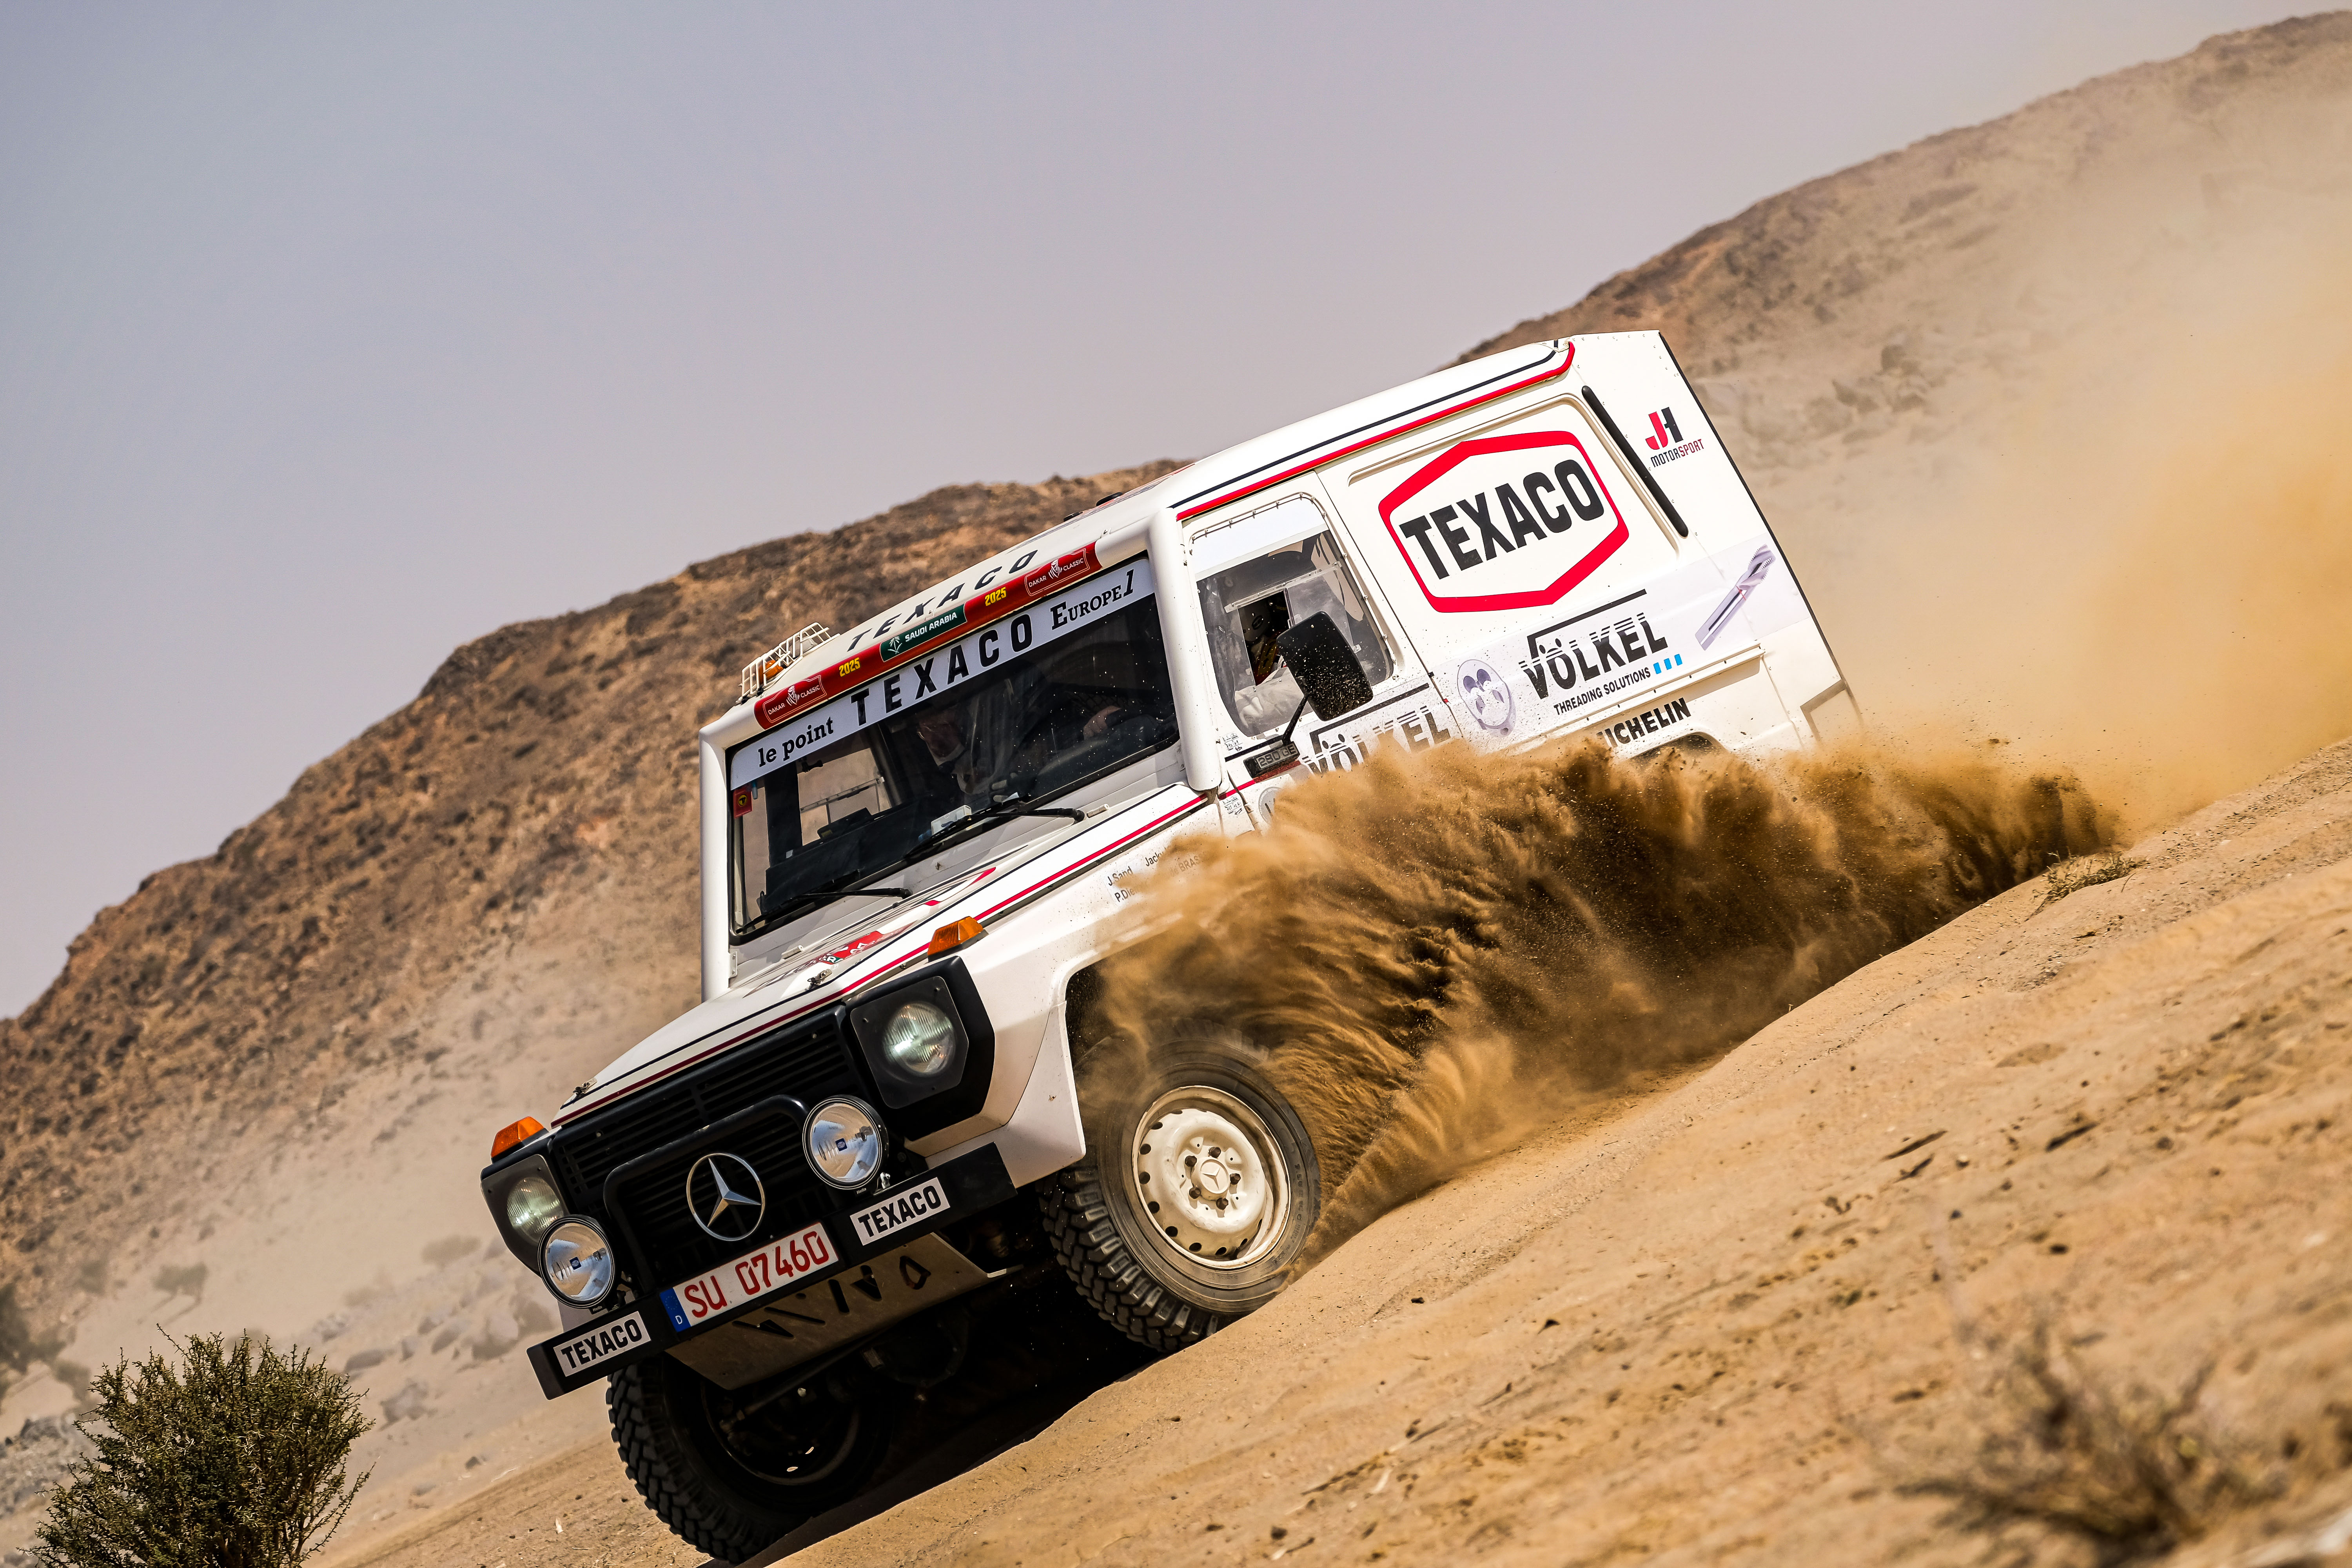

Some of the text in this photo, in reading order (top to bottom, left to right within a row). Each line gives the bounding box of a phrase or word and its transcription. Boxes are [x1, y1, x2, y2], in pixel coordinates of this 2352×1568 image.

[1650, 438, 1704, 468] MOTORSPORT
[1399, 459, 1604, 579] TEXACO
[985, 586, 1007, 606] 2025
[1029, 558, 1083, 588] DAKAR CLASSIC
[847, 550, 1038, 652] TEXACO
[905, 612, 958, 642] SAUDI ARABIA
[838, 657, 861, 677] 2025
[850, 614, 1033, 726] TEXACO
[1518, 612, 1668, 700] VÖLKEL
[768, 685, 820, 715] DAKAR CLASSIC
[1553, 667, 1651, 715] THREADING SOLUTIONS
[758, 716, 834, 768] le point
[1596, 697, 1691, 748] ICHELIN
[1282, 746, 1296, 757] GE
[858, 1185, 941, 1238] TEXACO
[684, 1231, 829, 1318] SU 07460
[561, 1318, 643, 1369] TEXACO
[675, 1315, 683, 1325] D
